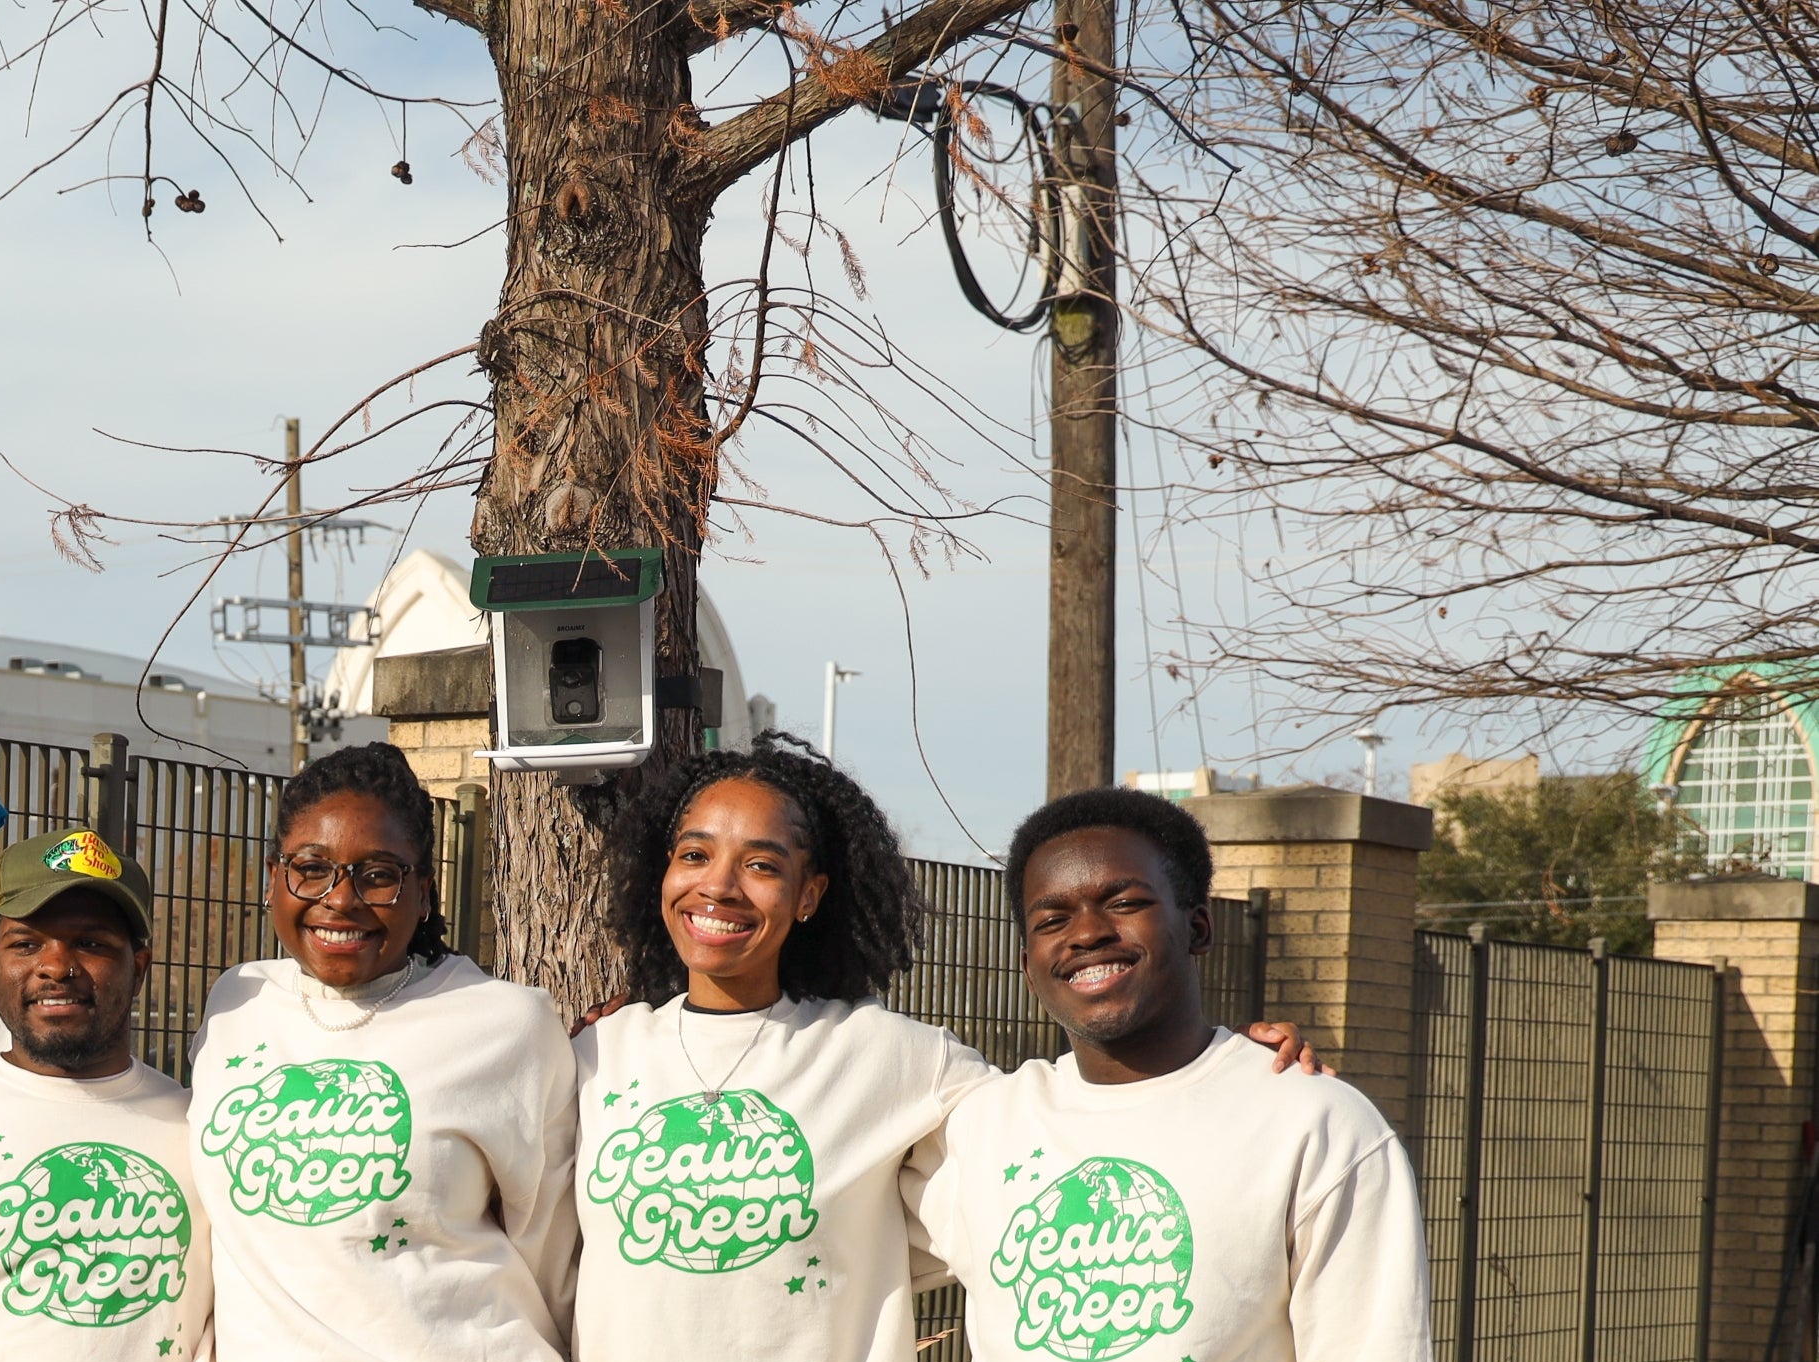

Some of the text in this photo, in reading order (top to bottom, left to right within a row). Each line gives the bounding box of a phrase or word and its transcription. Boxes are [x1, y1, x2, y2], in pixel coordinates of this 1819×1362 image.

[82, 833, 109, 854] Bass
[82, 855, 118, 877] Shops
[84, 844, 104, 859] Pro
[202, 1086, 404, 1155] Geaux
[231, 1143, 411, 1214] Green
[588, 1130, 804, 1202] Geaux
[620, 1190, 818, 1263] Green
[991, 1205, 1184, 1286] Geaux
[3, 1248, 185, 1315] Green
[1016, 1275, 1192, 1349] Green
